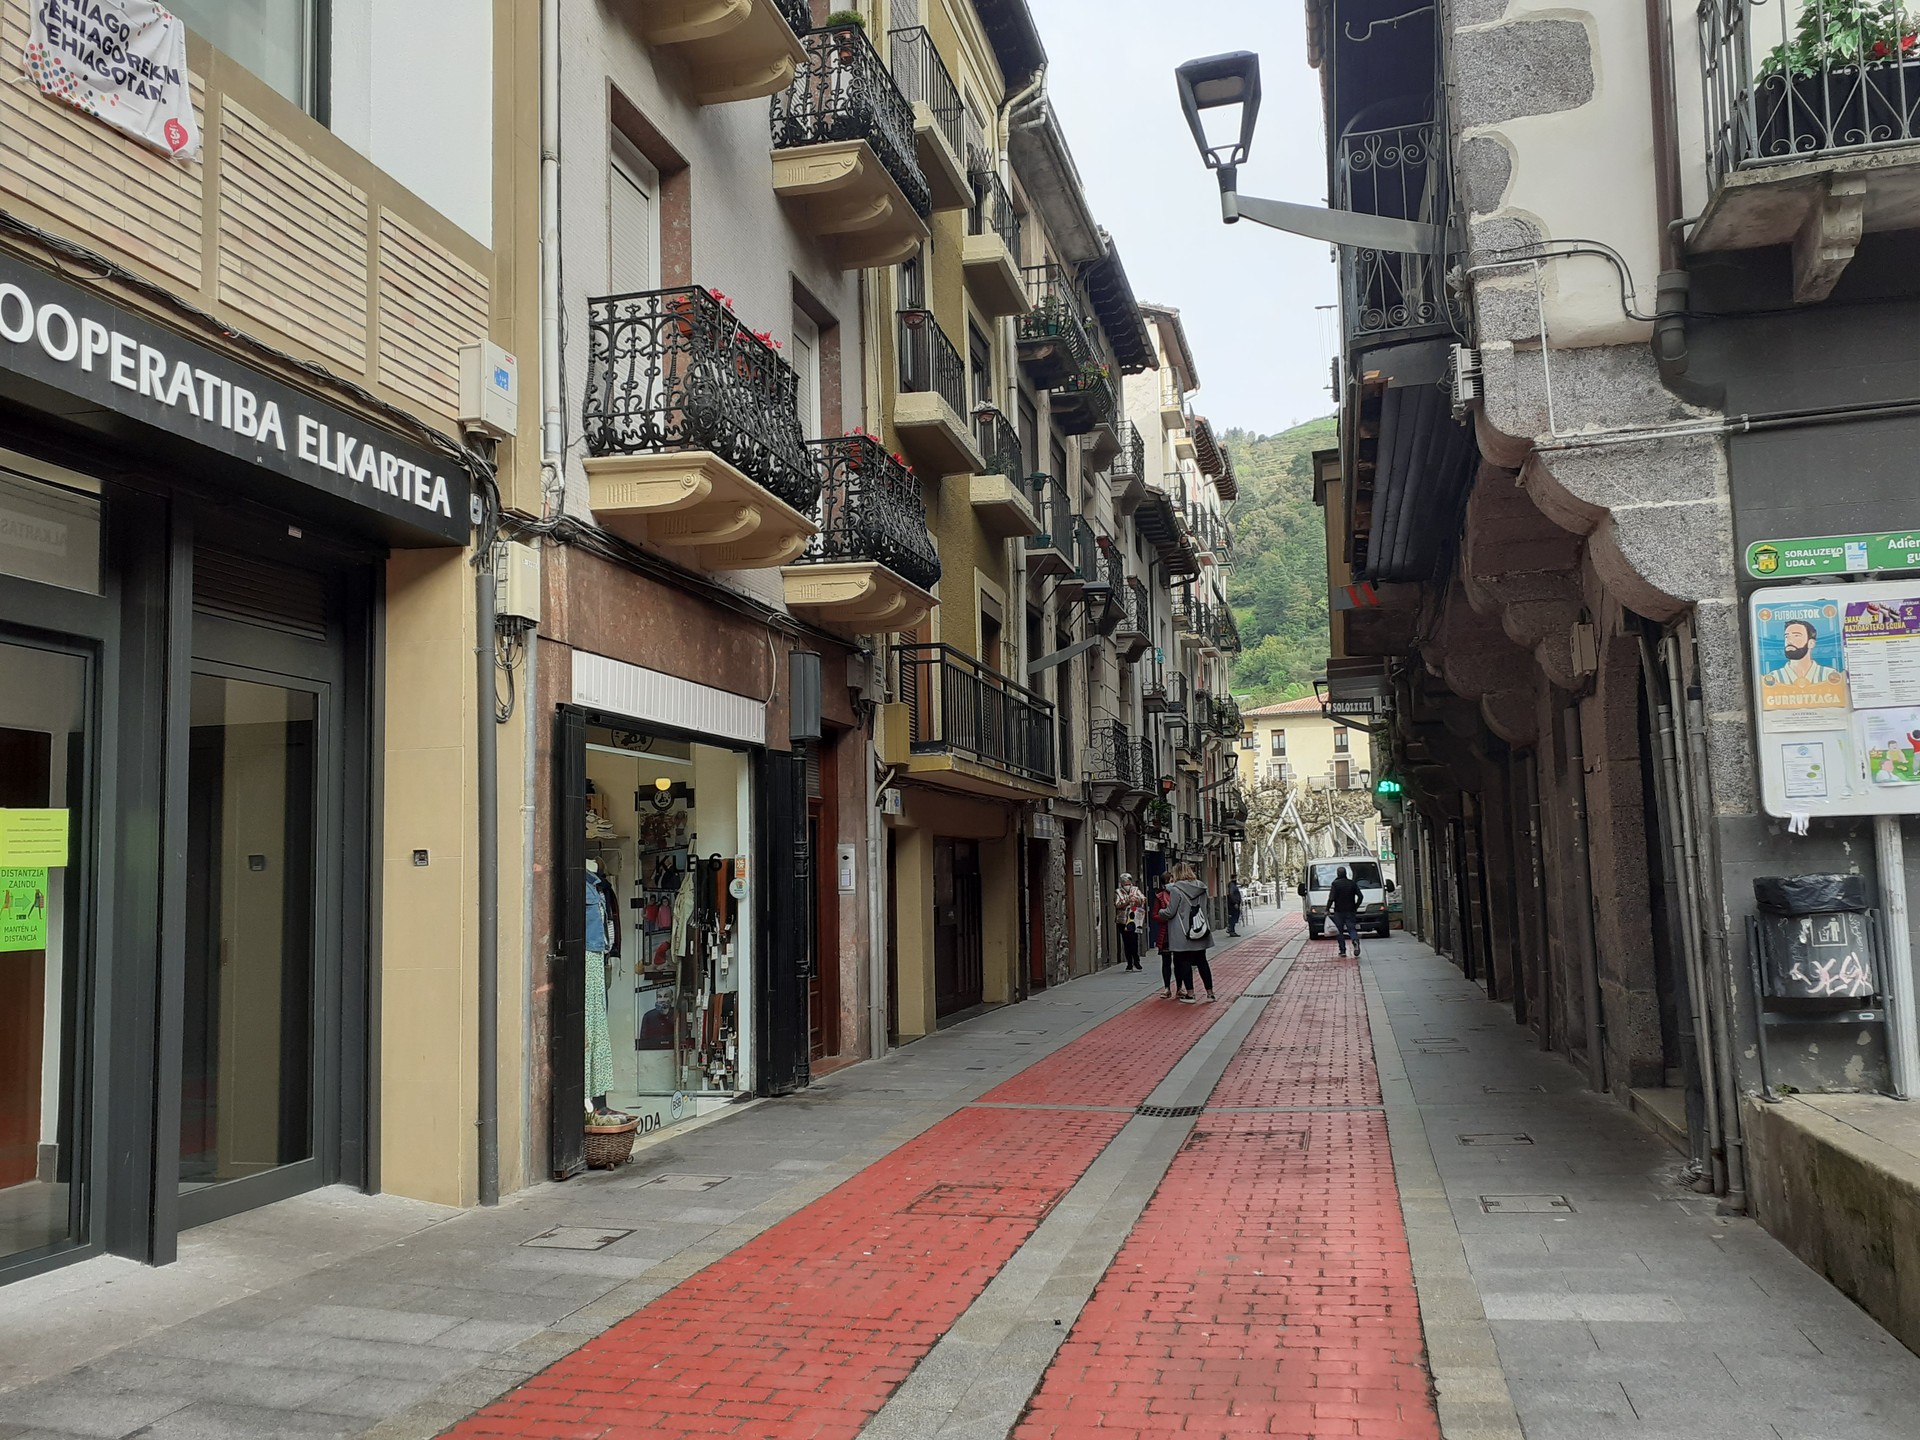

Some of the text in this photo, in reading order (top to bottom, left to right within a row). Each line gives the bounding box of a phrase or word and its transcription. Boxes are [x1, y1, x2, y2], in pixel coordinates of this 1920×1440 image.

[298, 415, 452, 518] ELKARTEA
[1784, 547, 1844, 558] SORALUZEKO
[1785, 559, 1816, 567] UDALA
[1774, 608, 1820, 620] FUTBOLISTOK
[1766, 693, 1841, 706] GURRUTXAGA
[1, 869, 44, 878] DISTANTZIA
[4, 925, 29, 933] MANTÉN
[635, 1112, 661, 1135] ODA
